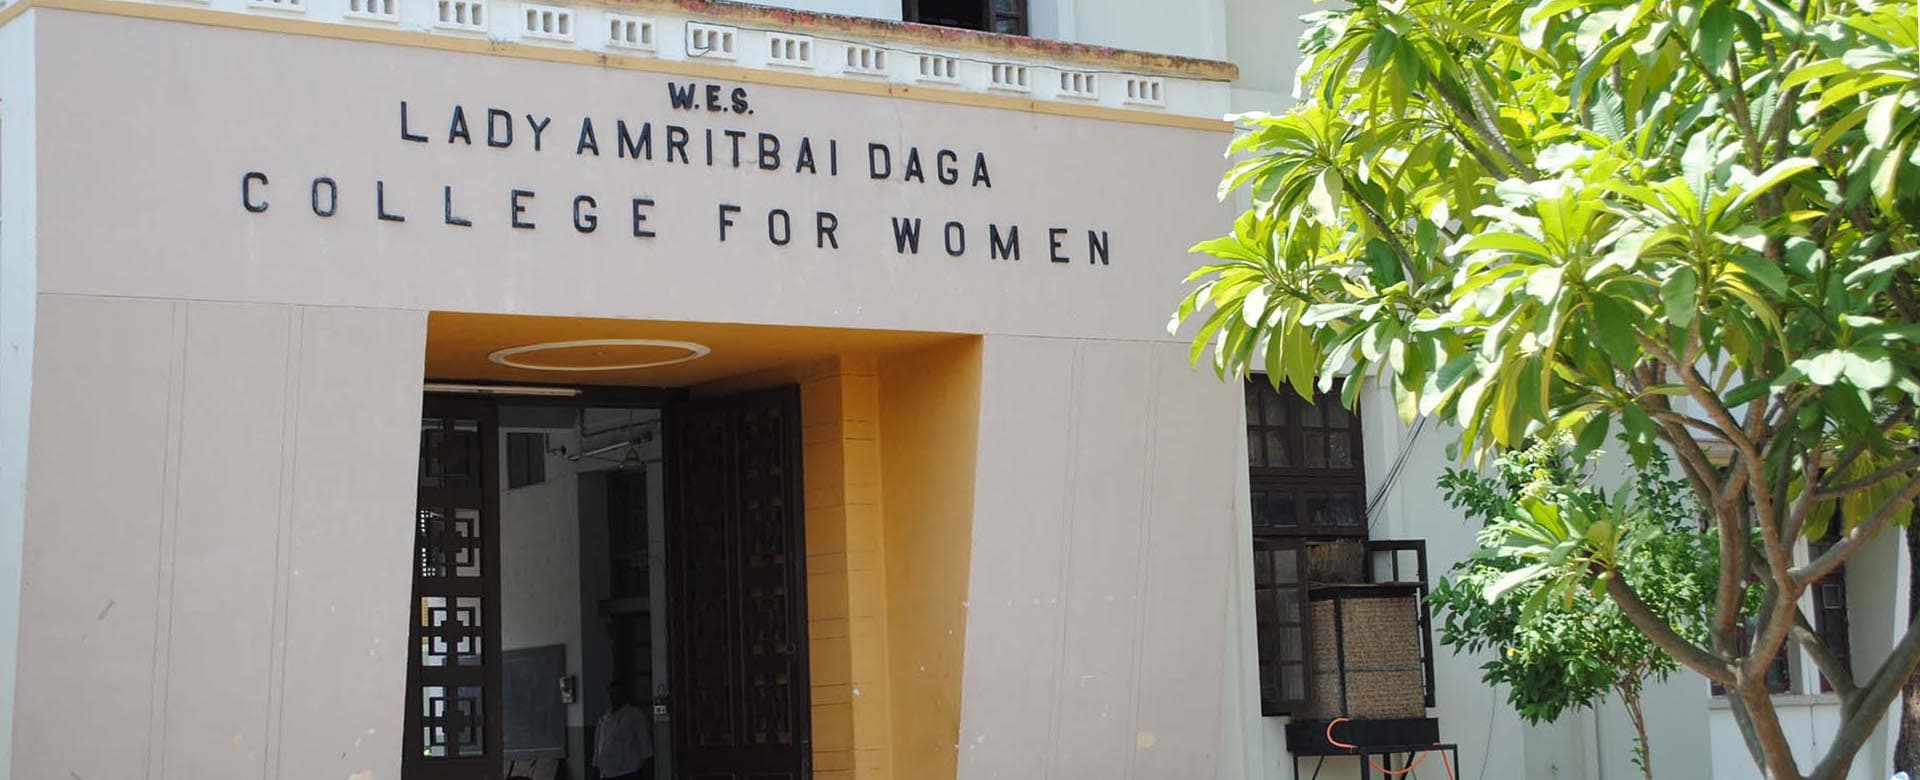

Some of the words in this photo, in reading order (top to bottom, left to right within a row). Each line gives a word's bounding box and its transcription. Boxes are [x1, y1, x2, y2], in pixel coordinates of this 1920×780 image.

[667, 82, 754, 116] W.E.S.
[400, 101, 552, 152] LADY
[576, 117, 839, 178] AMRITBAI
[868, 142, 992, 189] DAGA
[242, 171, 656, 238] COLLEGE
[718, 203, 839, 250] FOR
[891, 216, 1110, 266] WOMEN
